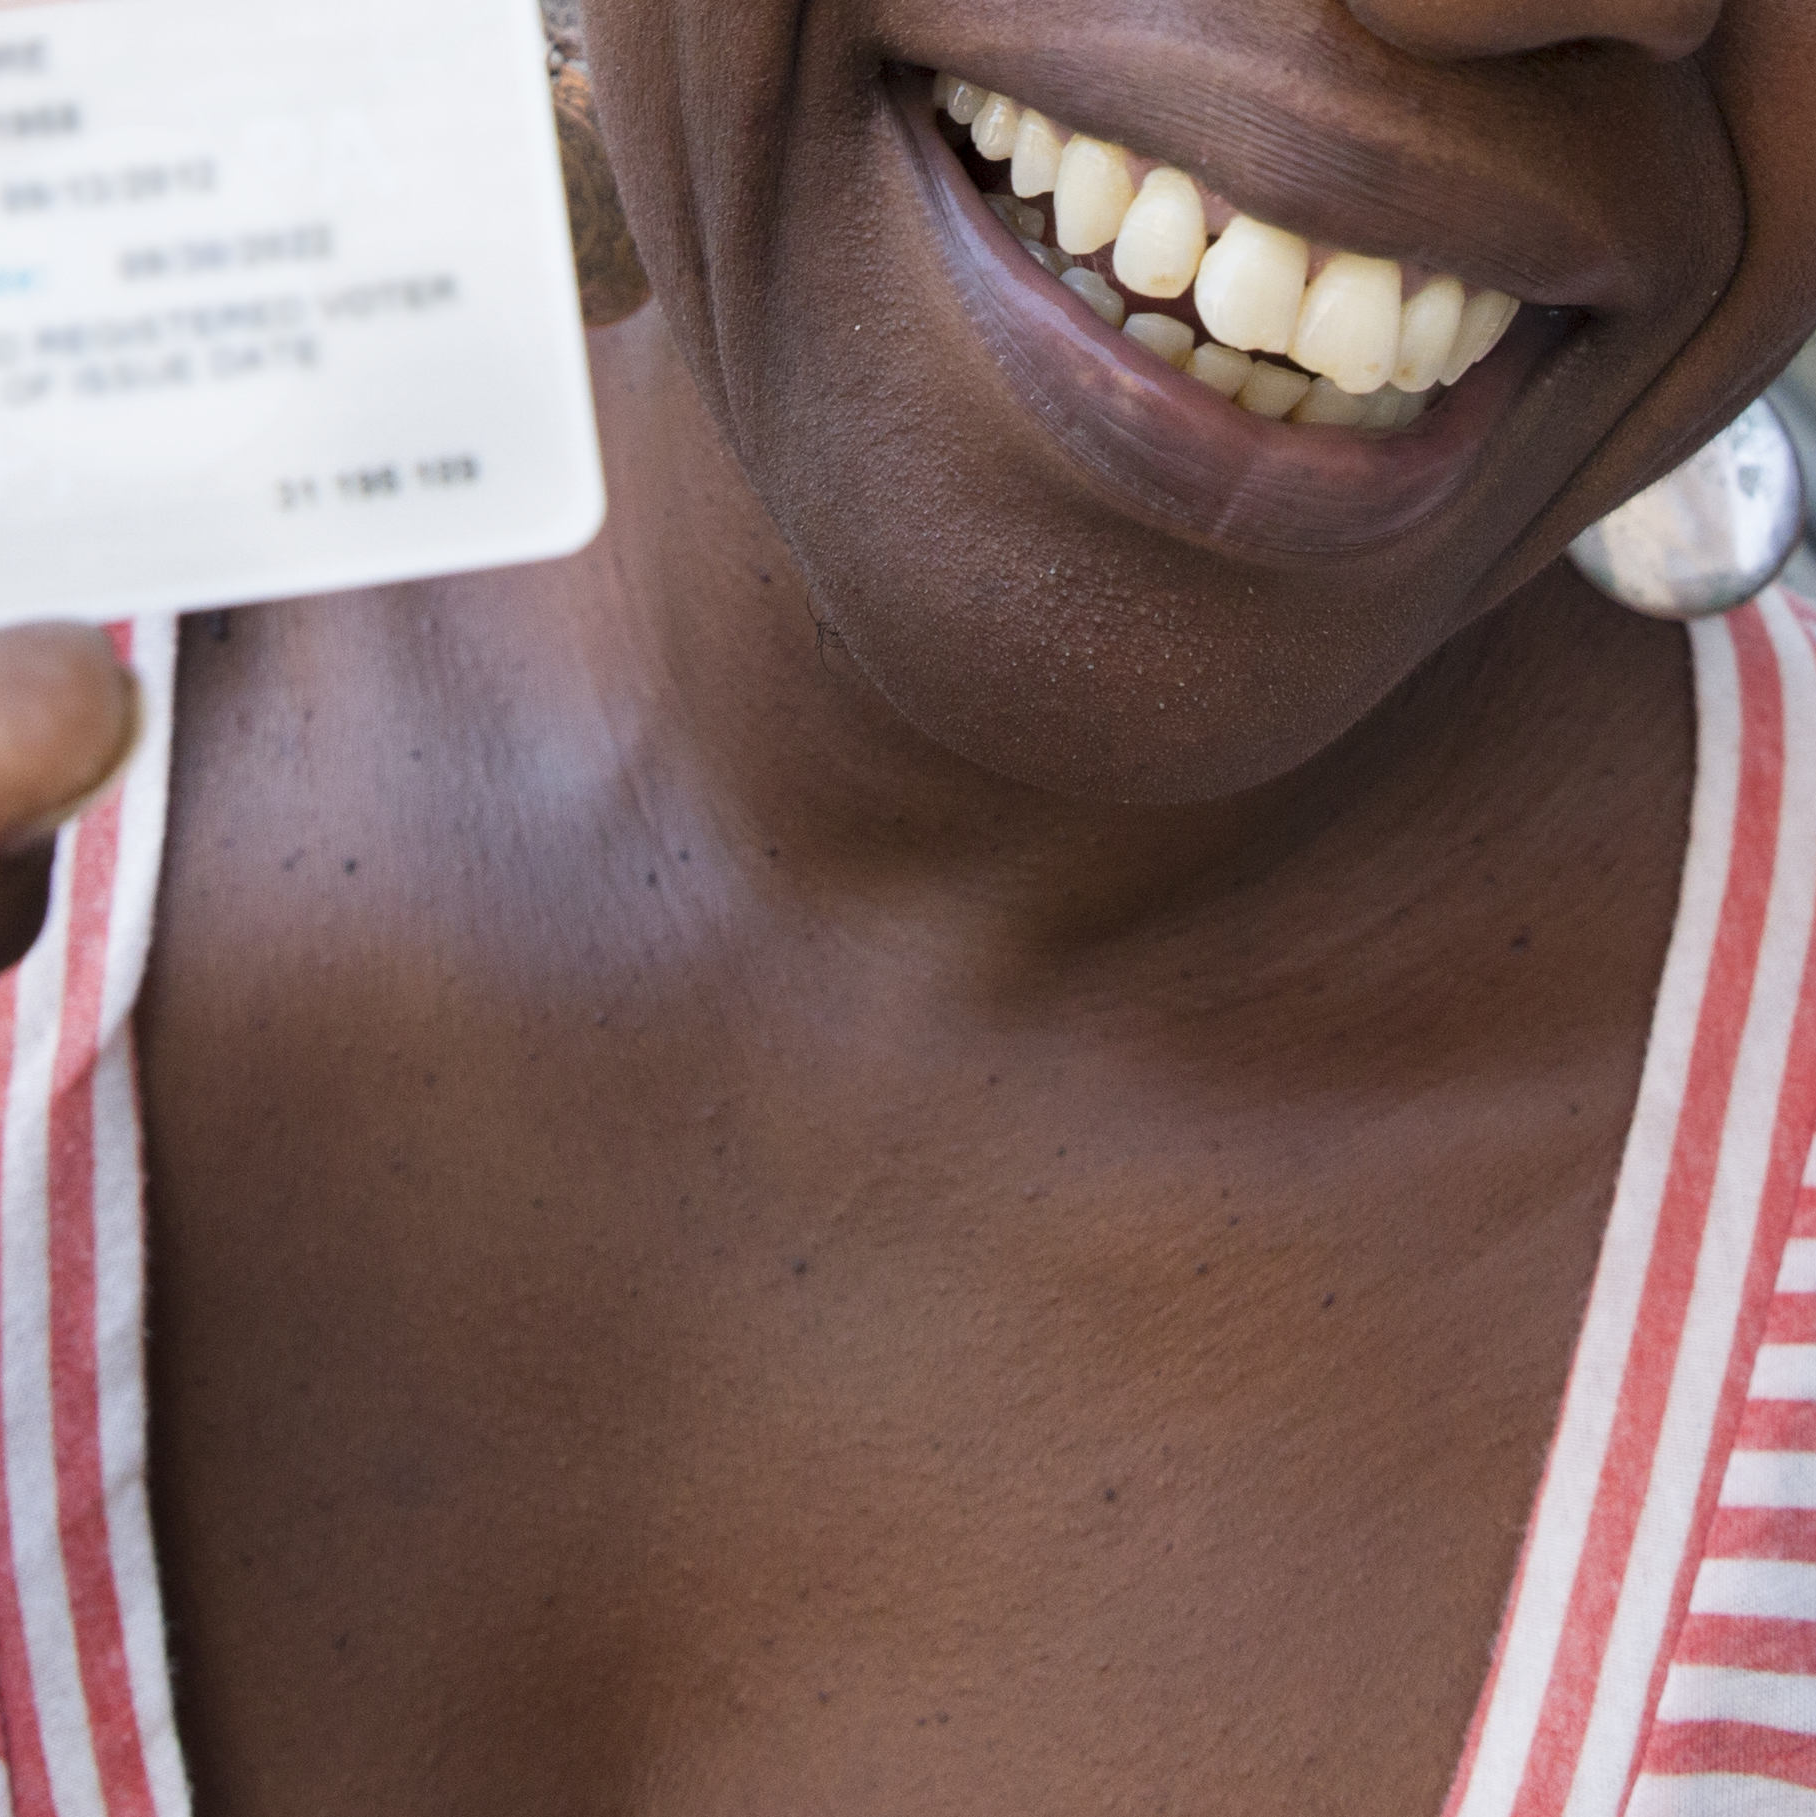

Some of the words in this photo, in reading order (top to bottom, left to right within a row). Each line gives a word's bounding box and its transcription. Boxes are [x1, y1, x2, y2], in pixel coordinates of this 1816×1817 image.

[33, 294, 307, 360] REGISTERED
[319, 271, 461, 323] VOTER
[3, 368, 58, 409] OF
[72, 352, 195, 401] ISSUE
[209, 333, 321, 383] DATE
